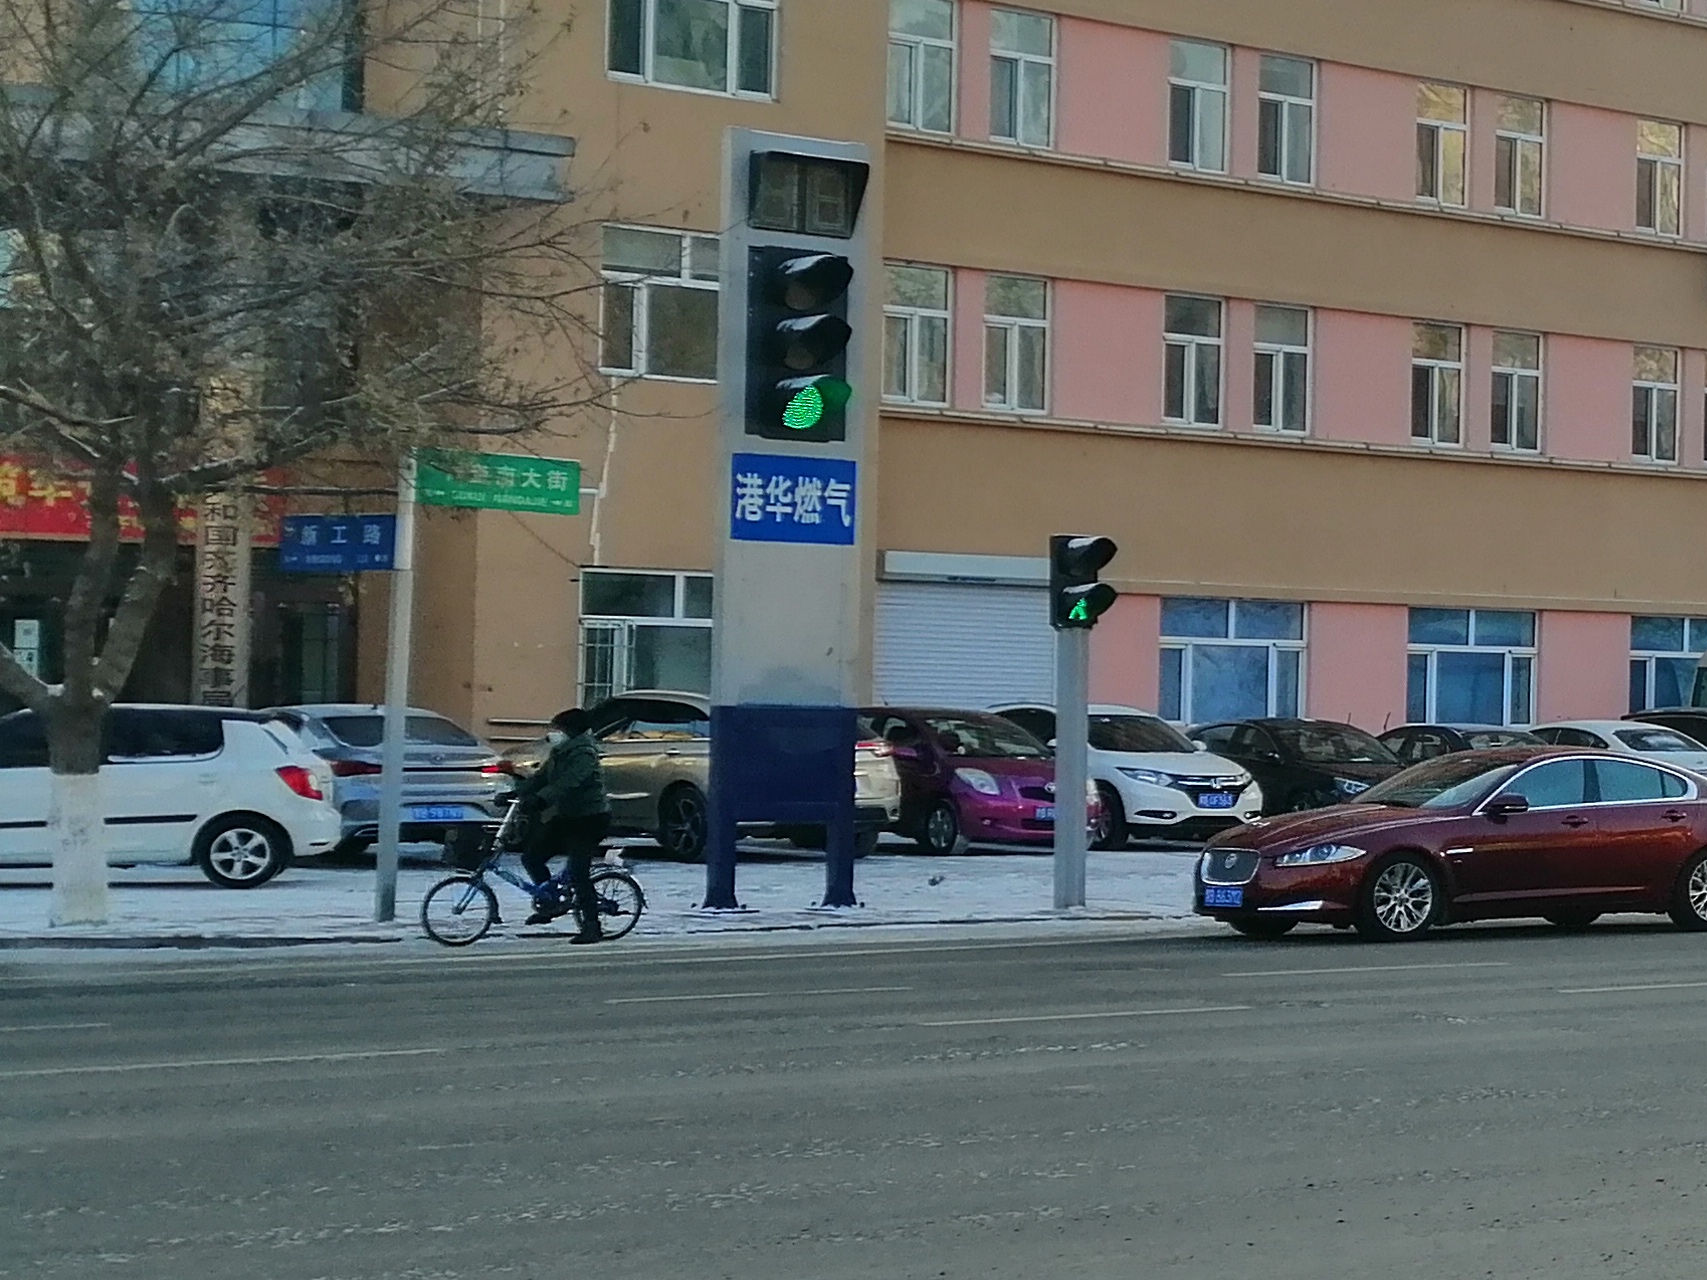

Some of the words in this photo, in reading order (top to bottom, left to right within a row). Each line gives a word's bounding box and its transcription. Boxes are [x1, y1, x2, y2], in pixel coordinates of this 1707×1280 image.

[735, 472, 851, 527] 港华燃气
[300, 524, 381, 546] 新工路
